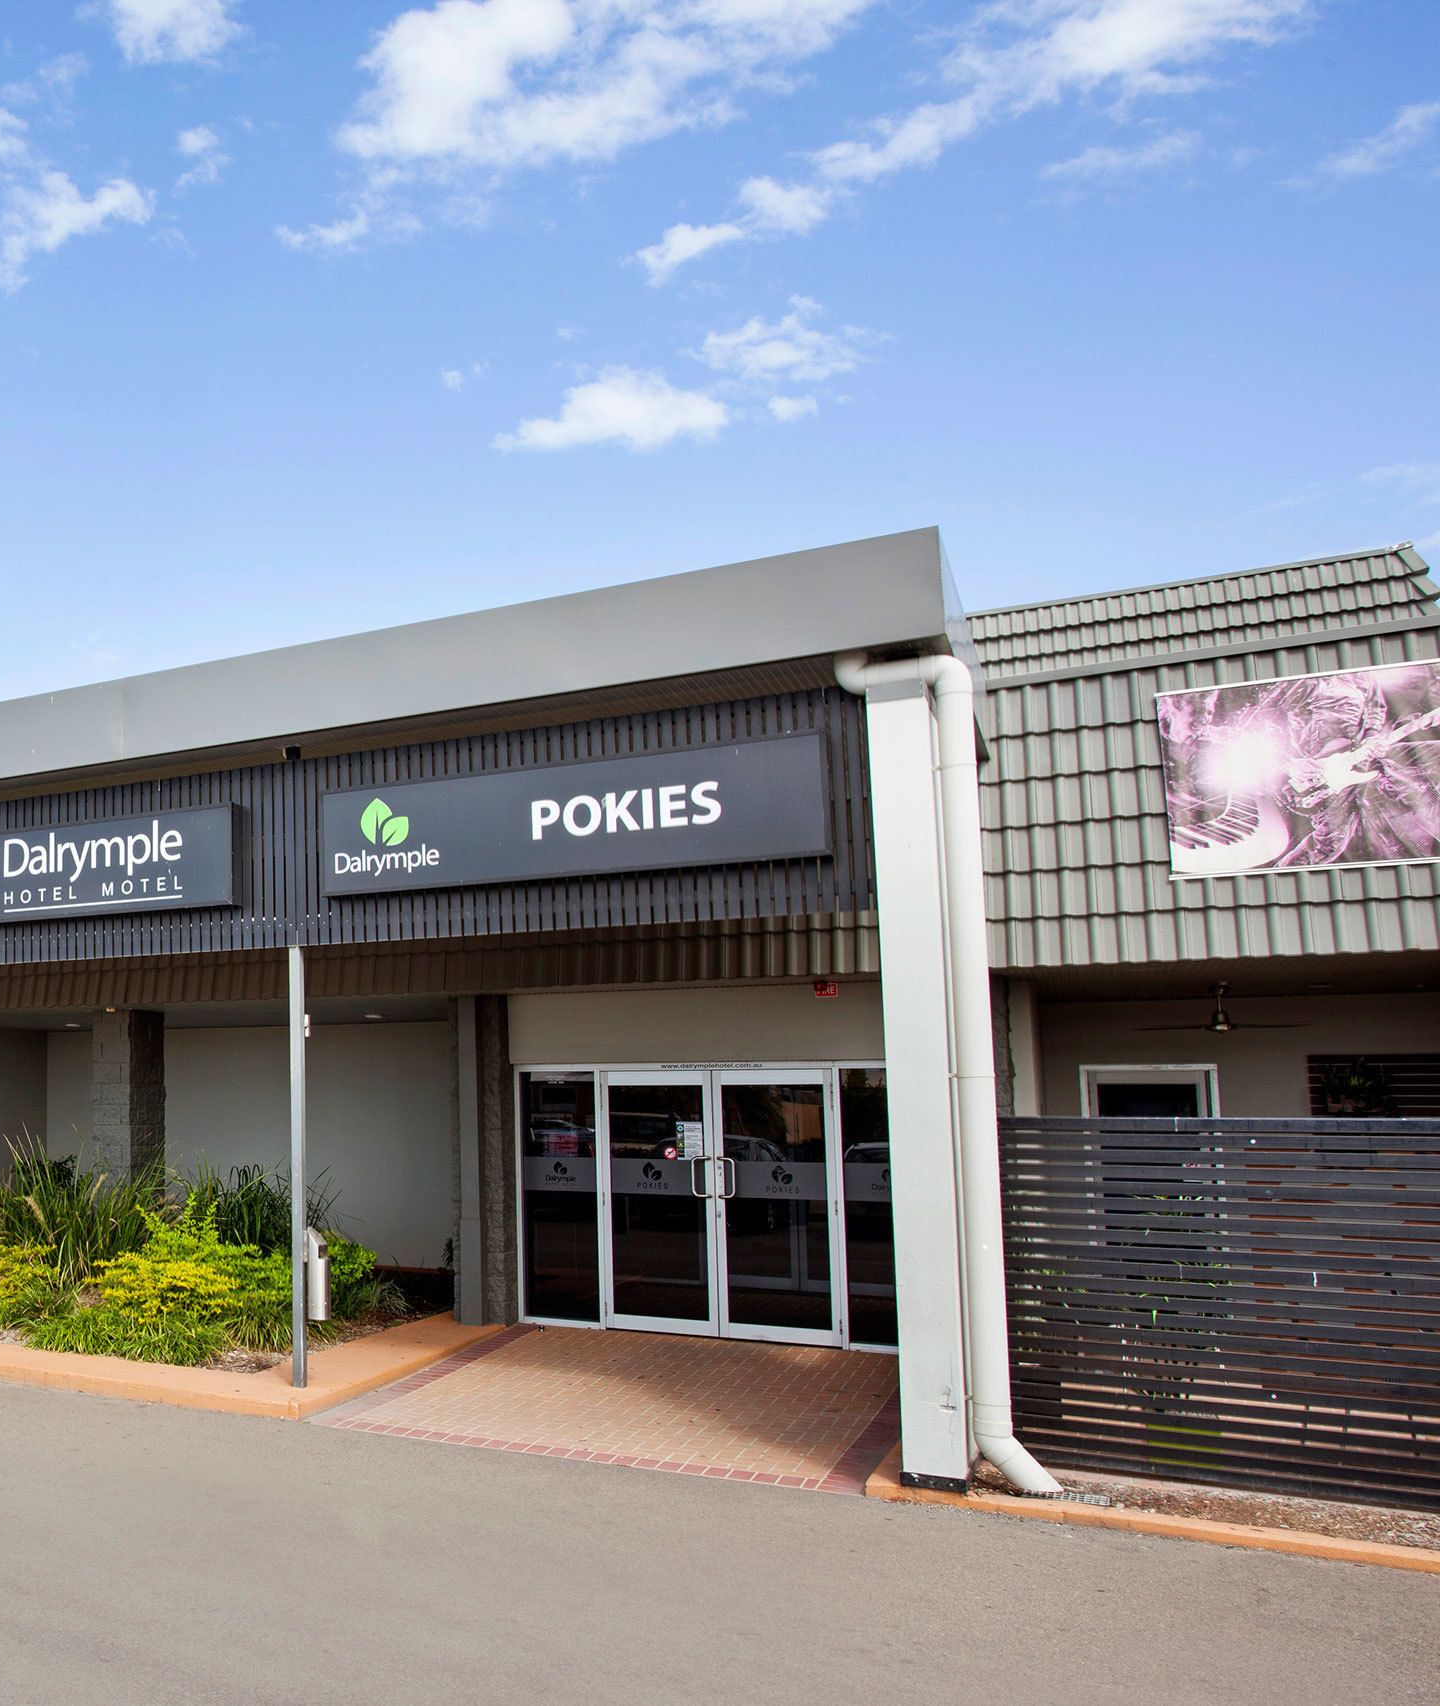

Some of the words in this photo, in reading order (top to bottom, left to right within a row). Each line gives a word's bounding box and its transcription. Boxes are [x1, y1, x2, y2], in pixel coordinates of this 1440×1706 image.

[530, 780, 723, 841] POKIES
[3, 820, 183, 883] Dalrymple
[334, 843, 440, 877] Dalrymple
[4, 884, 78, 906] HOTEL
[101, 875, 184, 897] MOTEL
[545, 1174, 576, 1183] Dalrymple
[636, 1181, 669, 1190] POKIES
[871, 1183, 890, 1194] Dalry
[765, 1185, 800, 1194] POKIES
